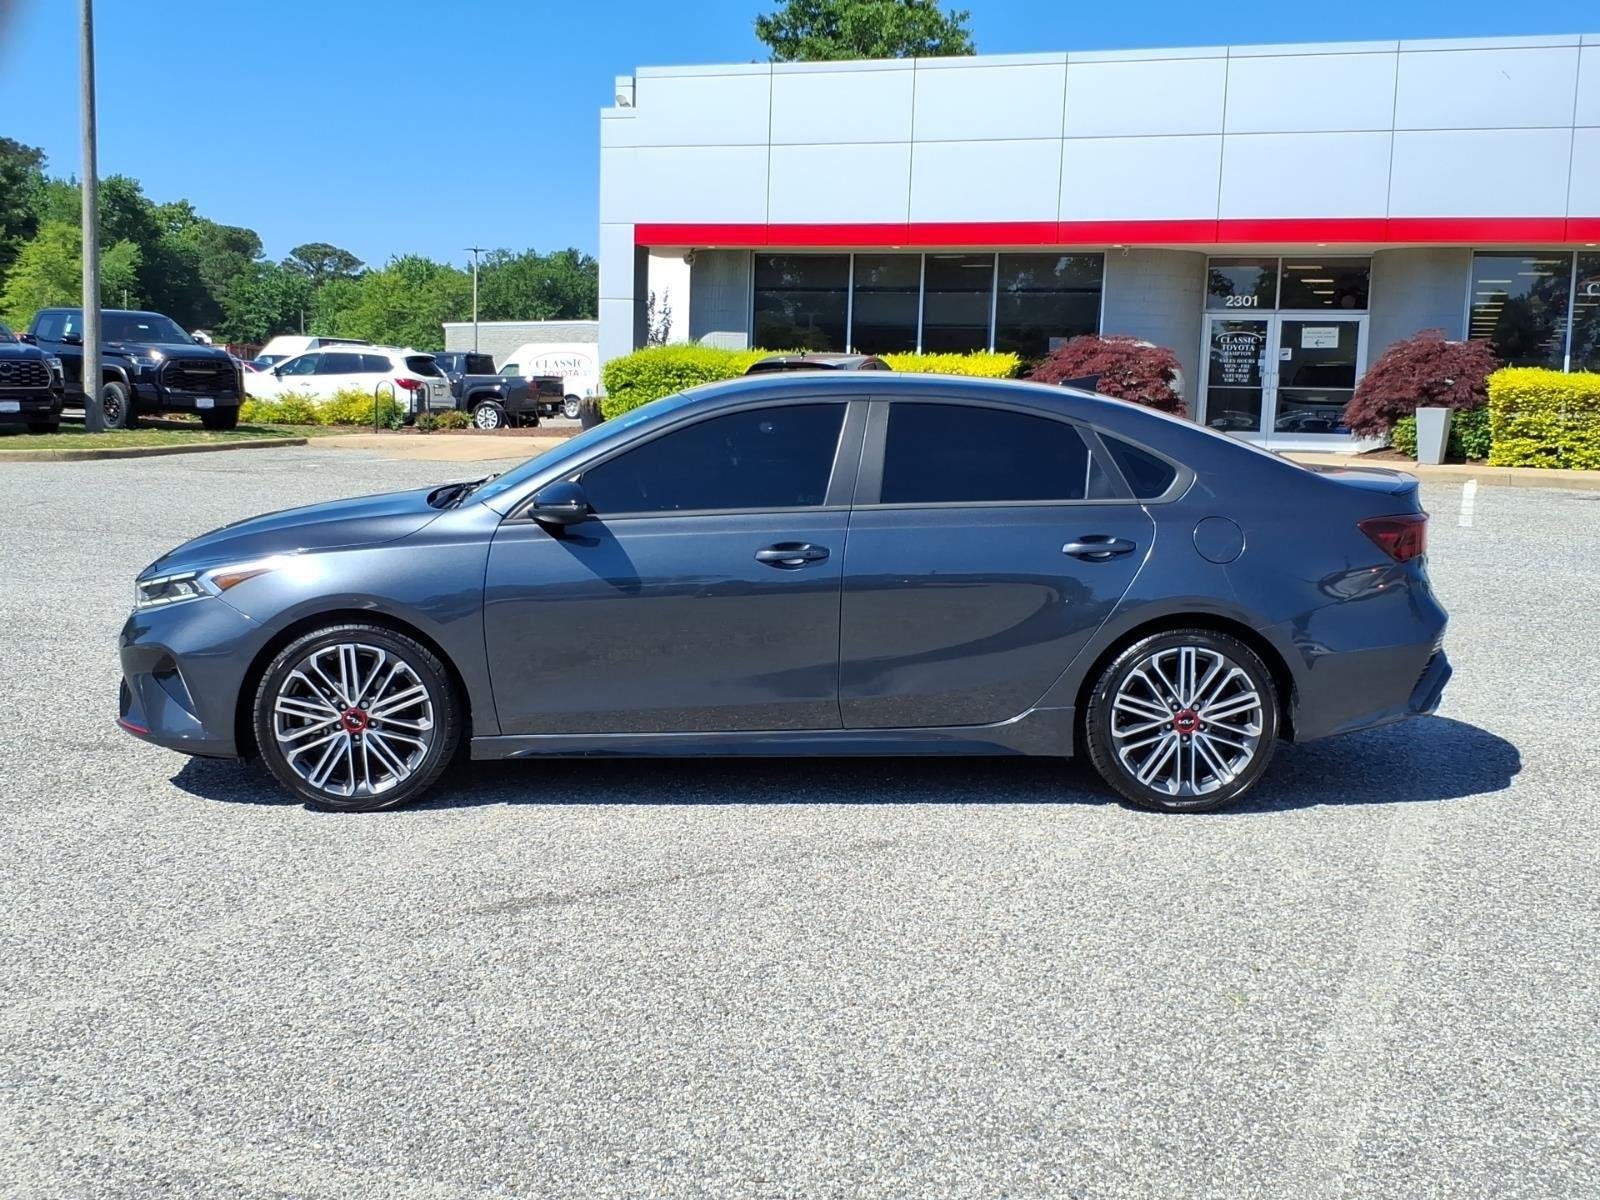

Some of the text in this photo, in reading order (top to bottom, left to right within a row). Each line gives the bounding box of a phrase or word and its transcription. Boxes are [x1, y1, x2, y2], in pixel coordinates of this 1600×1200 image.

[1225, 295, 1258, 307] 2301
[1220, 336, 1258, 344] CLASSIC
[1222, 344, 1255, 352] TOYOTA
[535, 359, 582, 369] CLASSIC
[543, 370, 580, 378] TOYOTA
